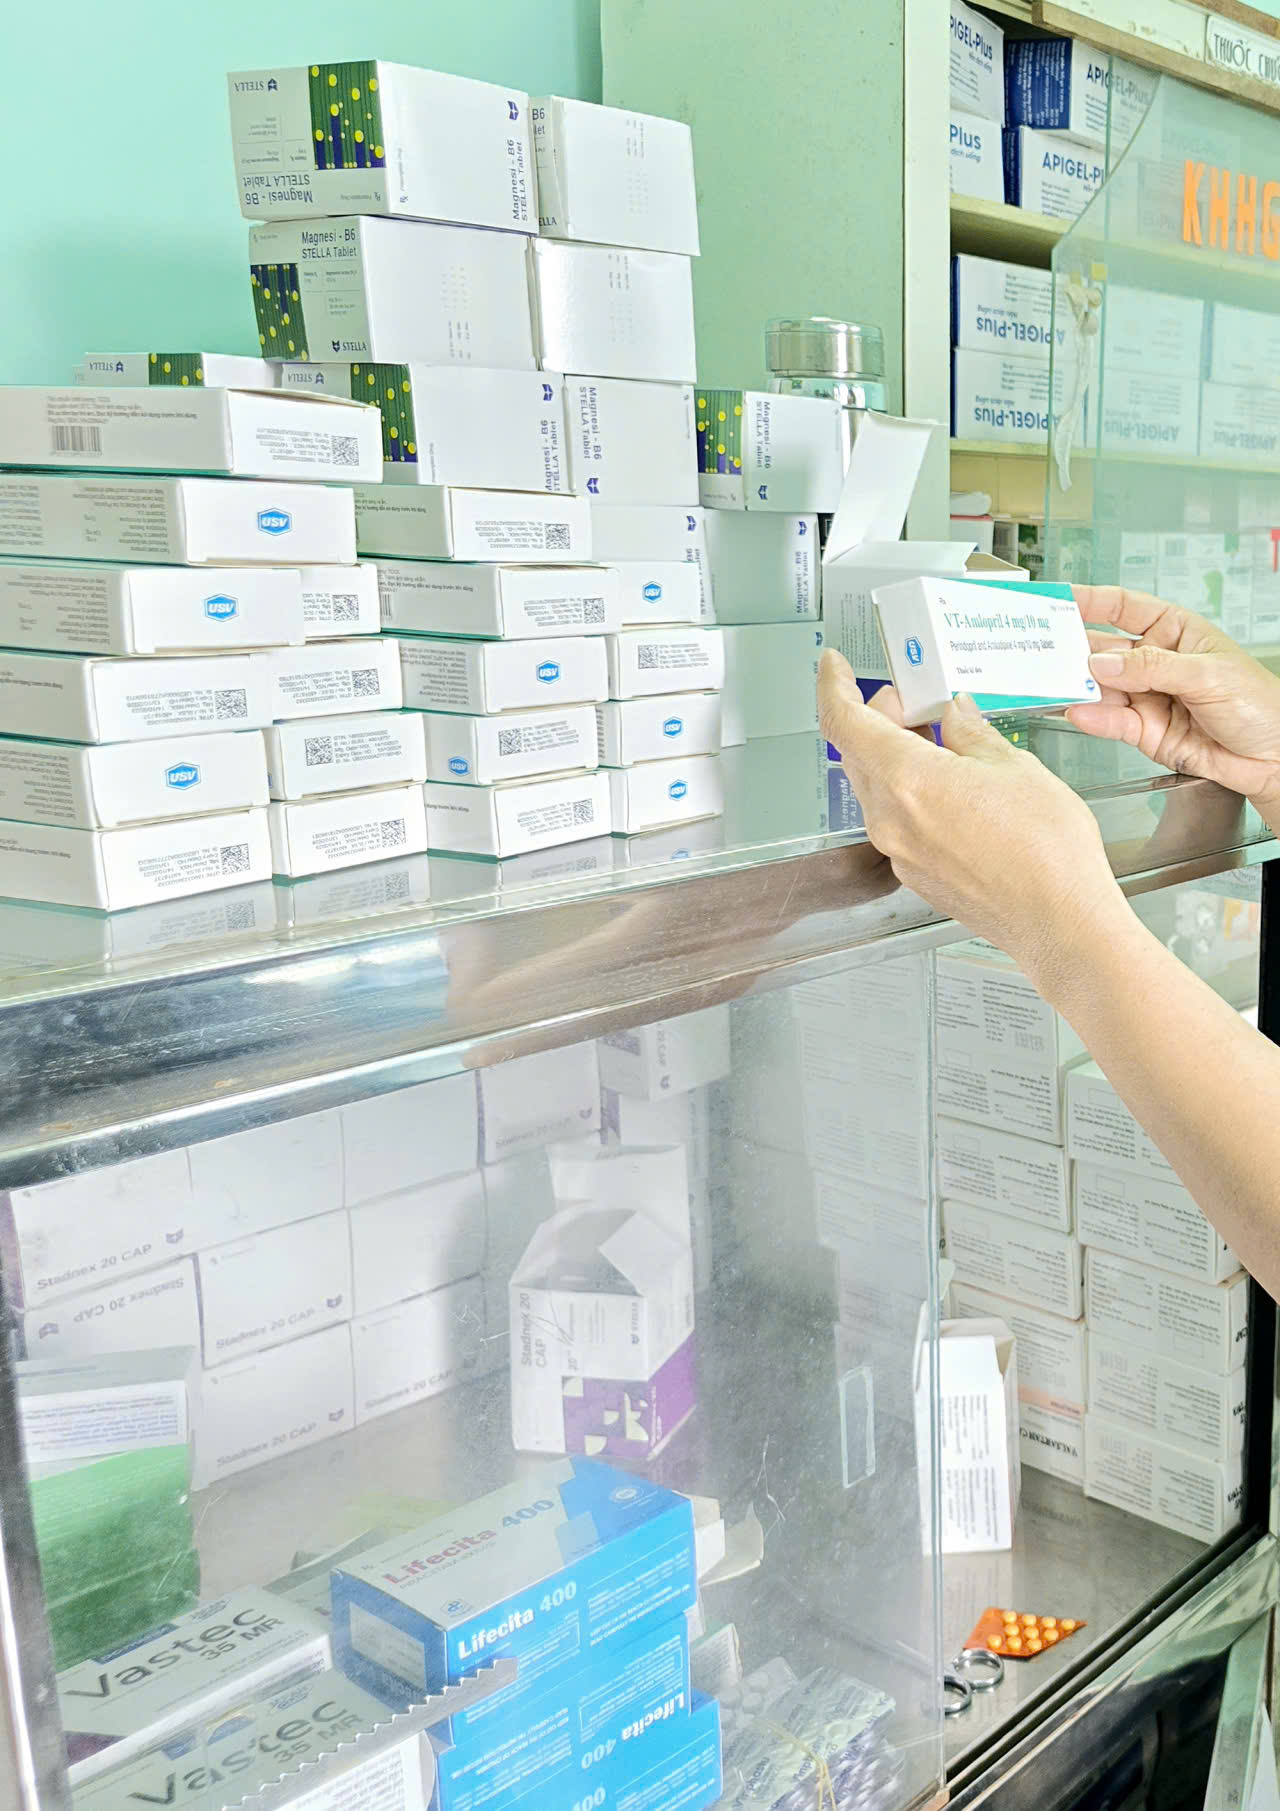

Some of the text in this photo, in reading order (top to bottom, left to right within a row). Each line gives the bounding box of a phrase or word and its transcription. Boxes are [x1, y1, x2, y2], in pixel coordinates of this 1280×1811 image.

[950, 15, 993, 61] PIGEL-Plus
[234, 82, 264, 92] STELLA
[1042, 152, 1105, 185] APIGEL-Pl
[243, 174, 311, 187] STELLA Tablet
[245, 189, 314, 205] Magnesi B6
[518, 179, 528, 222] STELLA
[539, 216, 557, 227] ELLA
[302, 228, 356, 246] Magnesi B6
[302, 246, 357, 259] STELLA Tablet
[343, 343, 367, 351] STELLA
[89, 362, 114, 371] STELLA
[288, 373, 313, 383] STELLA
[579, 386, 589, 427] STELLA
[588, 386, 602, 460] Magnesi B6
[261, 514, 289, 528] USV
[643, 586, 661, 598] USV
[207, 601, 235, 615] USV
[944, 613, 1004, 632] VT-Amlopril
[1005, 614, 1011, 628] 4
[1039, 617, 1051, 632] mg
[908, 640, 920, 662] USV
[538, 666, 560, 678] USV
[664, 721, 682, 734] USV
[170, 768, 197, 783] USV
[450, 761, 469, 772] USV
[668, 784, 687, 798] USV
[37, 1243, 152, 1290] Stadnex 20 CAP
[73, 1278, 185, 1323] Stadnex 20 CAP
[535, 1338, 547, 1368] CAP
[382, 1499, 555, 1585] Lifecita 400
[457, 1607, 534, 1660] Lifecita
[538, 1581, 577, 1613] 400
[200, 1617, 285, 1661] 35 MR
[64, 1608, 268, 1698] Vastec
[621, 1691, 685, 1741] Lifecita
[273, 1741, 311, 1764] 35
[580, 1738, 616, 1769] 400
